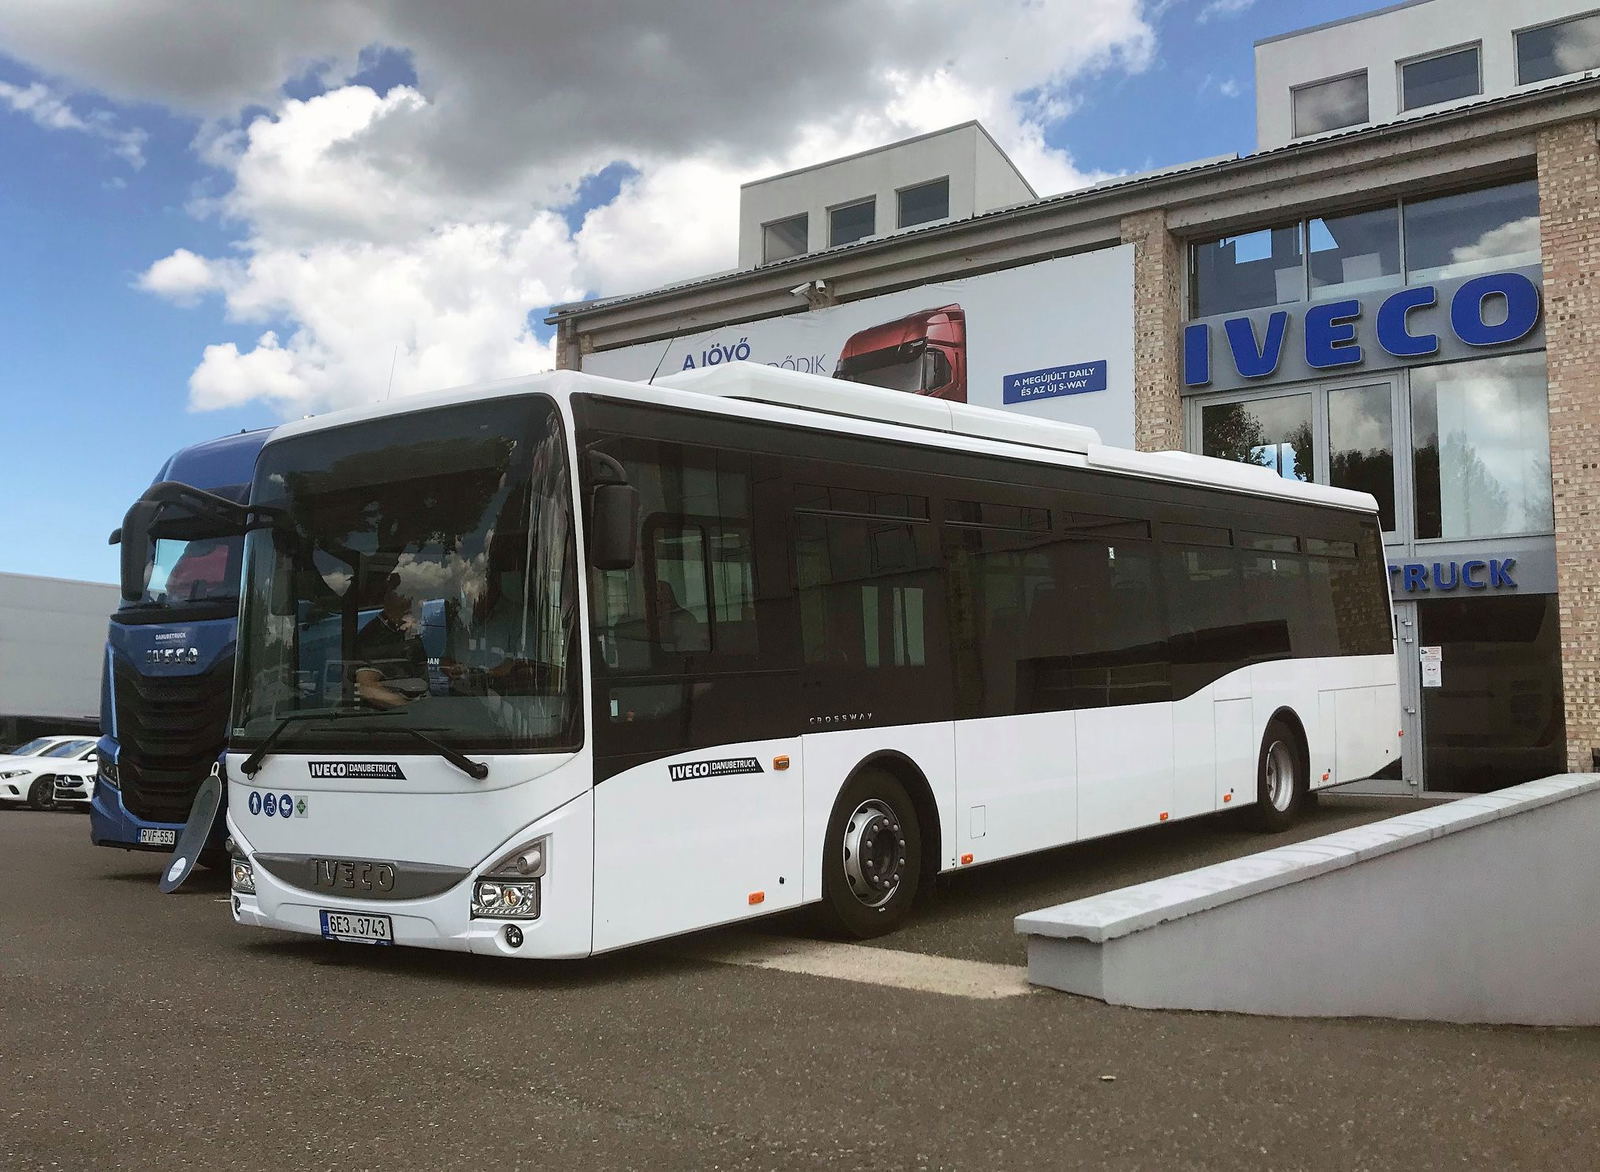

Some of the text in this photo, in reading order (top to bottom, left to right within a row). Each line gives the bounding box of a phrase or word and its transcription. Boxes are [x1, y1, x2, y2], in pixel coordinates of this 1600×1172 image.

[1184, 272, 1541, 386] IVECO
[682, 354, 696, 371] A
[767, 353, 827, 374] ŐDIK
[1013, 379, 1021, 388] A
[1069, 367, 1095, 379] DAILY
[1021, 380, 1088, 397] ÉS AZ ÚJ S-WAY
[809, 712, 872, 725] CROSSWAY
[311, 763, 347, 776] IVECO
[349, 763, 397, 773] DANUBETRUCK
[672, 763, 709, 780] IVECO
[712, 759, 756, 771] DANUBETRUCK
[142, 830, 174, 844] RVF-553
[311, 858, 396, 892] IVECO
